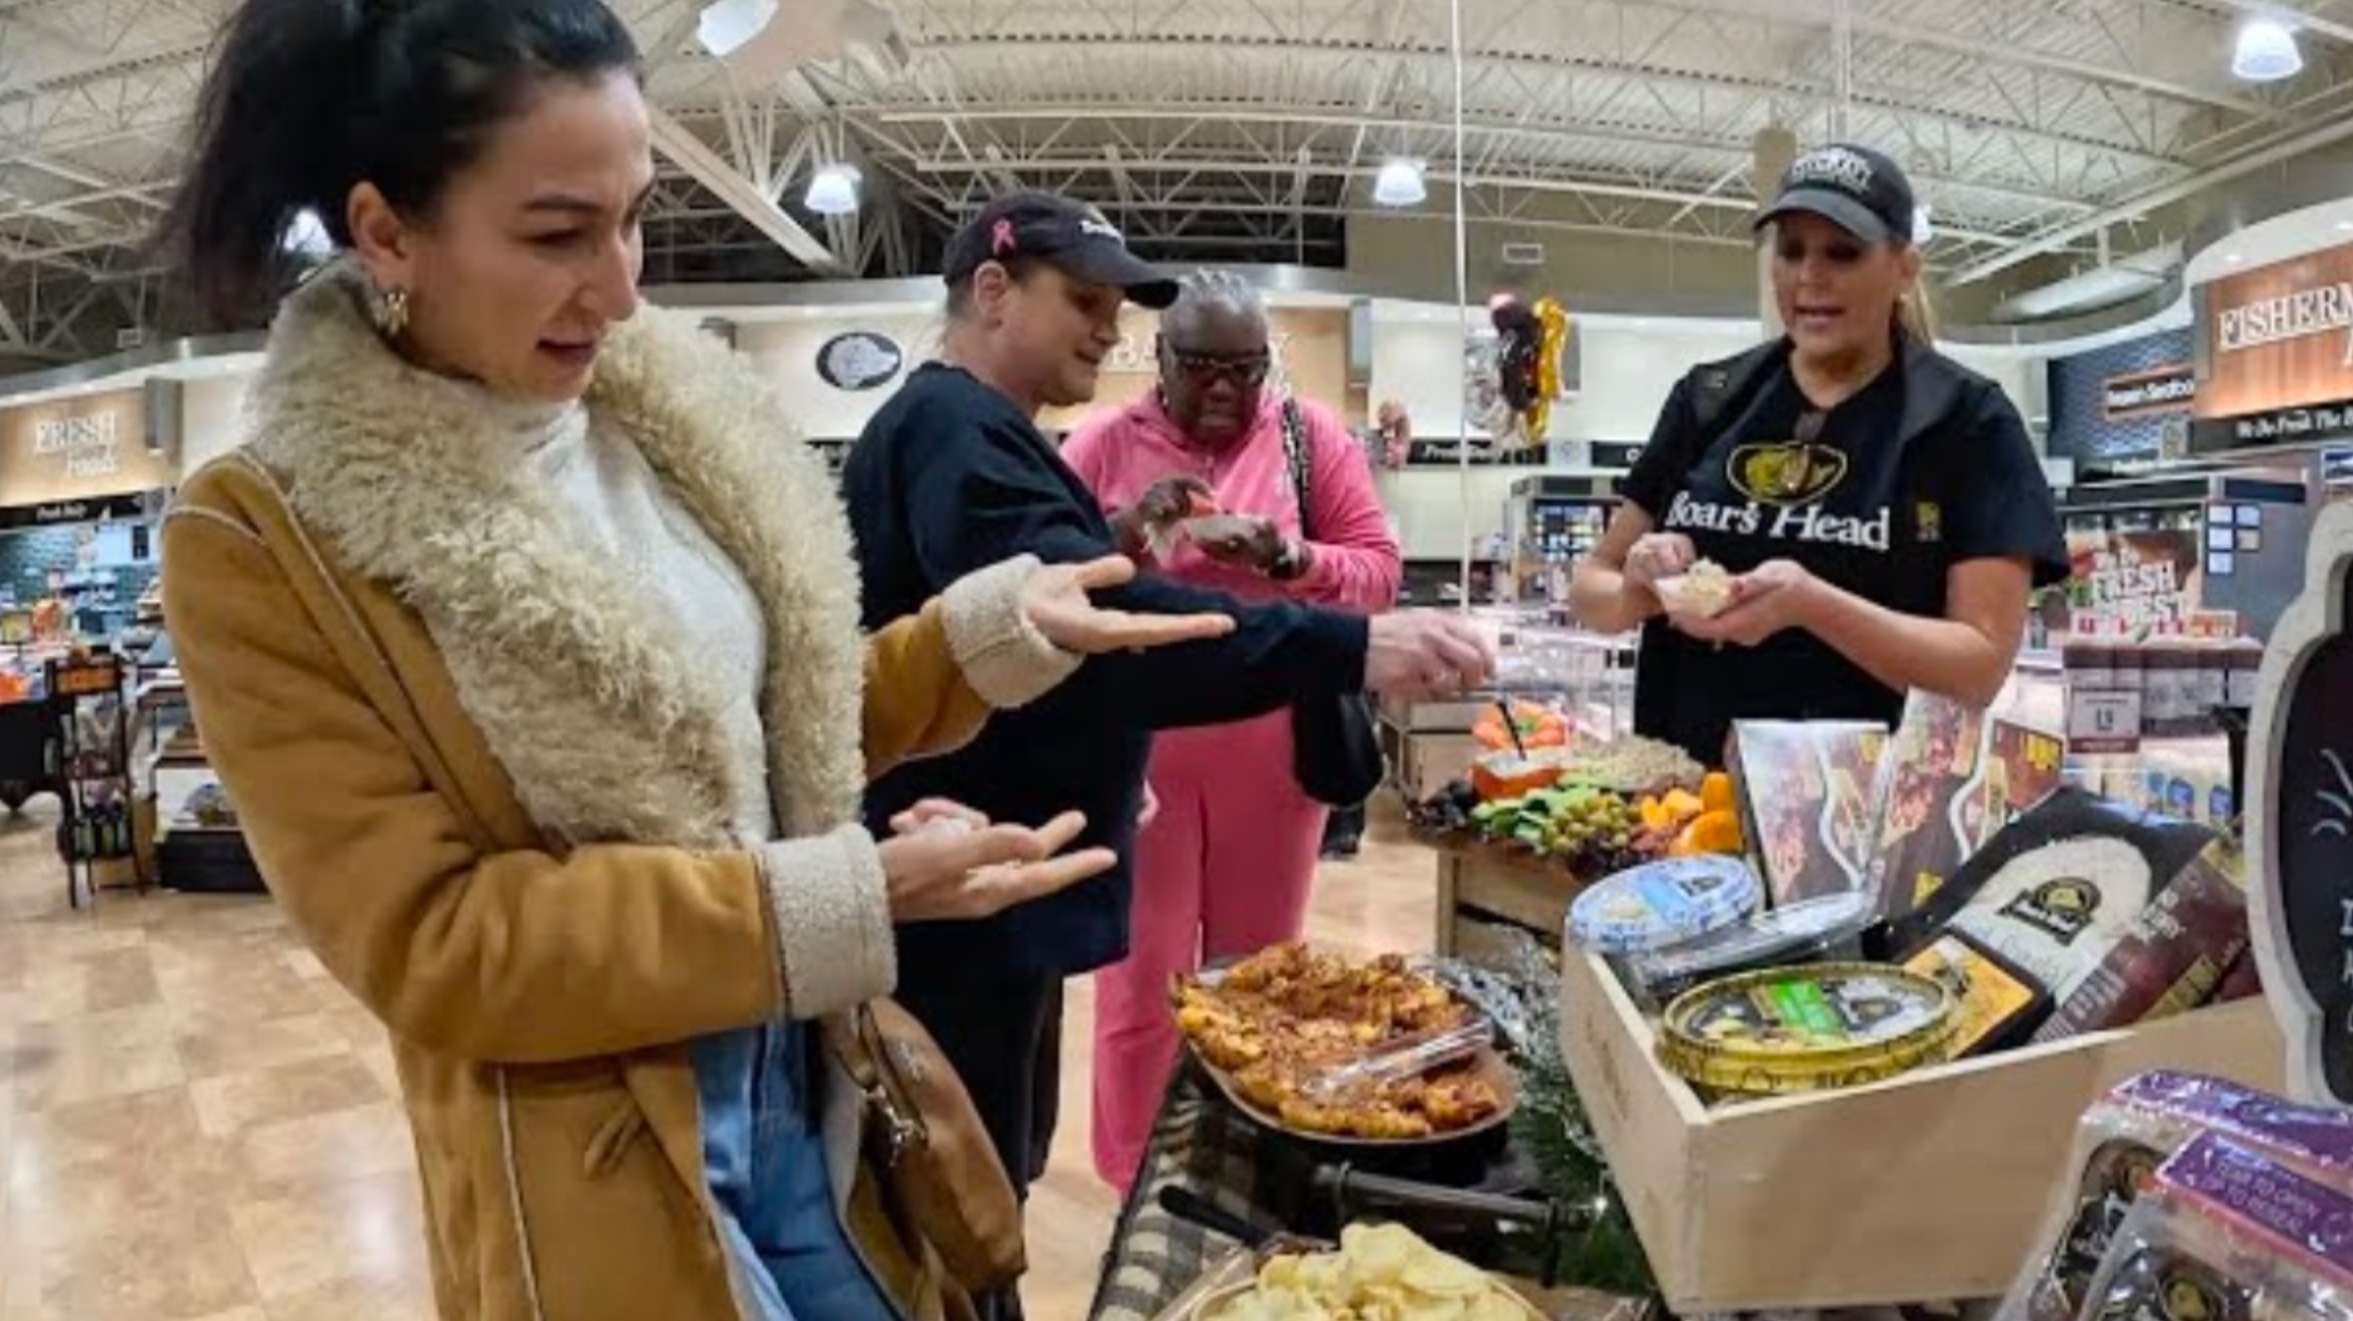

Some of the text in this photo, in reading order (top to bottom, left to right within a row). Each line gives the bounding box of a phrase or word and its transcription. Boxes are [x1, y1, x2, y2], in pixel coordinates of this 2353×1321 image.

[36, 410, 118, 453] FRESH
[1768, 503, 1890, 551] Head
[2092, 559, 2177, 602] FRESH
